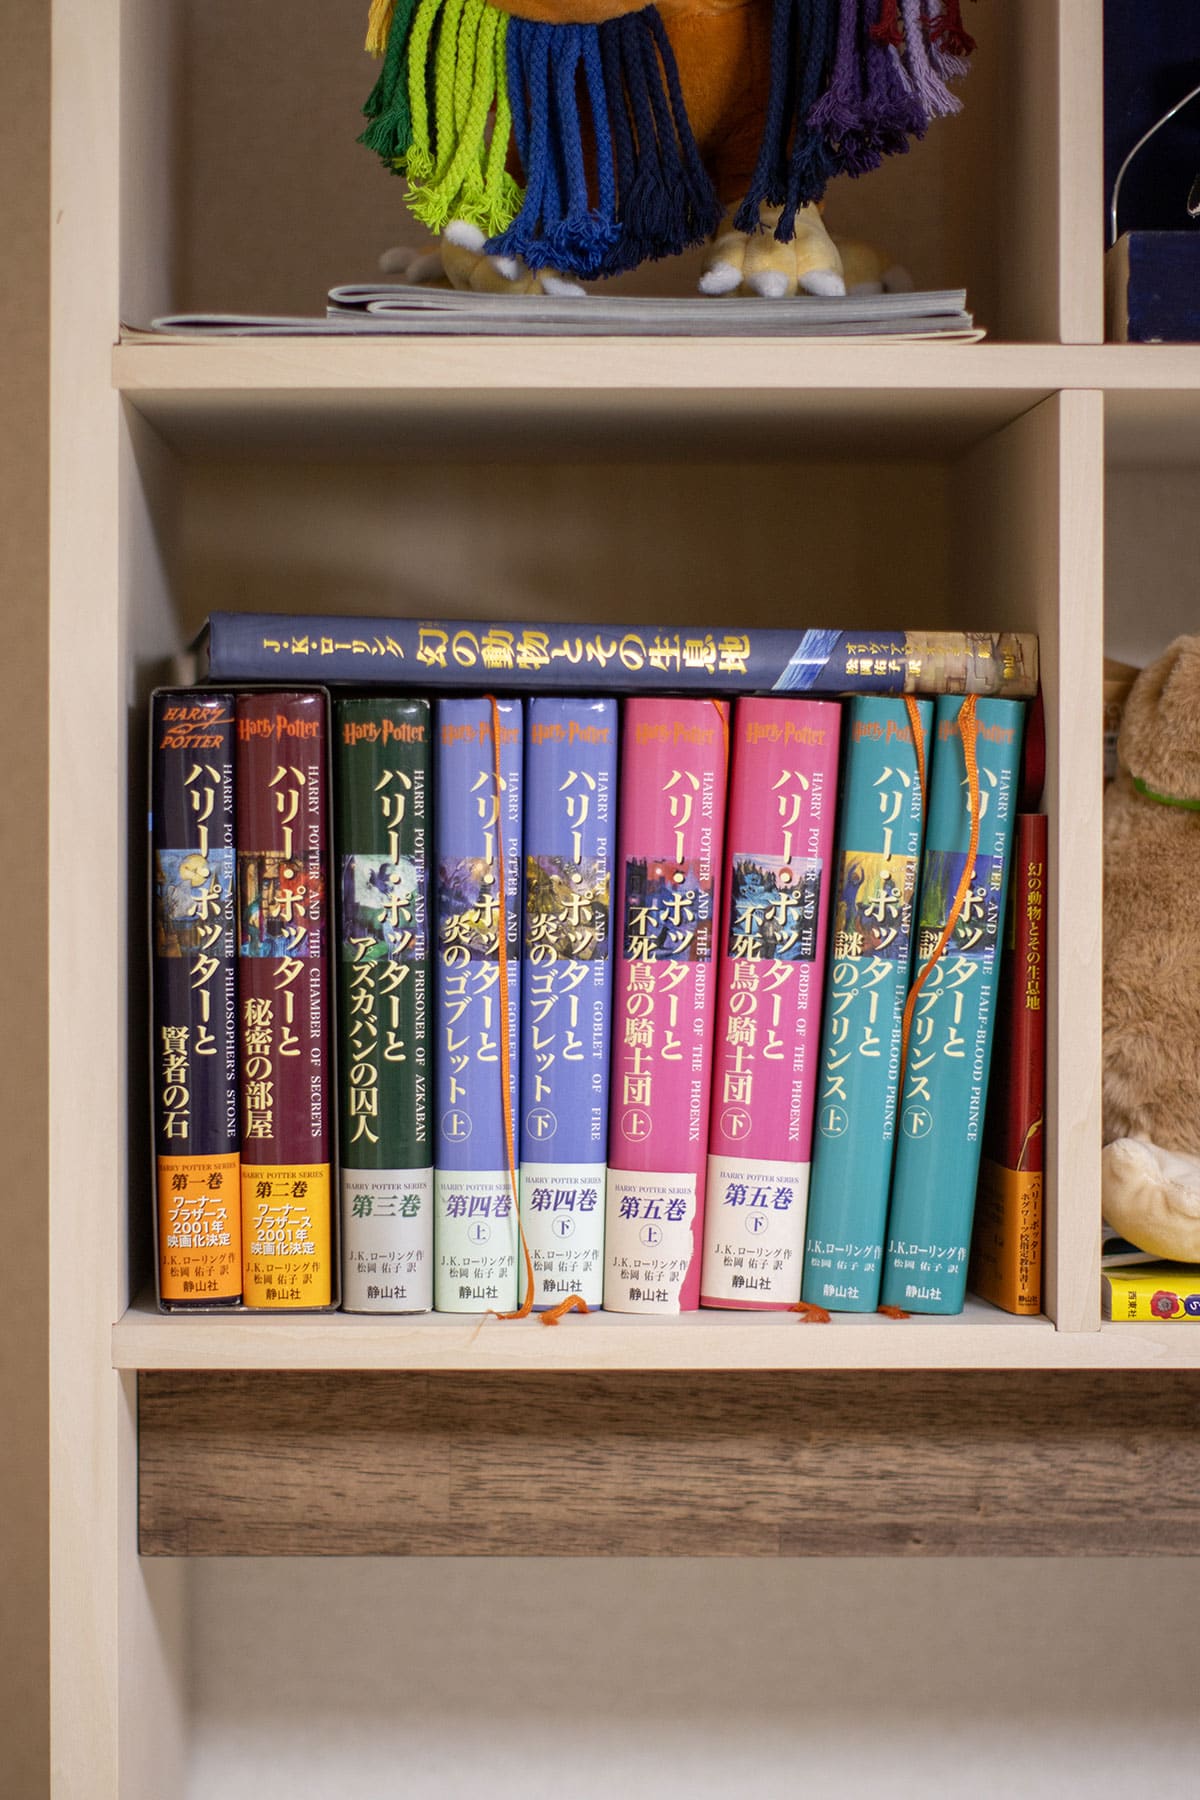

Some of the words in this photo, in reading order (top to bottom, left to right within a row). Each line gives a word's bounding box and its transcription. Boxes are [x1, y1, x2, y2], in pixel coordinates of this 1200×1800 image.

[416, 628, 751, 675] 幻の動物とその生息地
[162, 707, 227, 722] HARRY
[239, 719, 276, 742] Harry
[276, 714, 320, 742] Potter
[160, 735, 224, 749] POTTER
[343, 722, 381, 746] Harry
[382, 719, 425, 747] Potter
[531, 723, 567, 746] Harry
[568, 720, 610, 747] Potter
[636, 722, 672, 746] Harry
[673, 721, 715, 747] Potter
[746, 721, 783, 745] Harry
[784, 721, 826, 747] Potter
[852, 721, 885, 744] Harry
[223, 764, 233, 814] HARRY
[308, 765, 319, 815] HARRY
[414, 770, 425, 819] HARRY
[508, 772, 519, 823] HARRY
[597, 771, 608, 823] HARRY
[703, 772, 714, 819] HARRY
[810, 772, 824, 820] HARRY
[996, 769, 1011, 821] HARRY
[223, 823, 233, 880] POTTER
[308, 824, 320, 880] POTTER
[414, 828, 425, 884] POTTER
[596, 838, 607, 896] POTTER
[699, 828, 712, 881] POTTER
[806, 828, 820, 881] POTTER
[989, 832, 1006, 892] POTTER
[507, 838, 518, 897] POTTER
[184, 764, 223, 1057] ハリー・ポッターと
[223, 892, 234, 920] AND
[268, 765, 307, 1056] ハリー・ポッターと
[309, 895, 320, 920] AND
[374, 769, 412, 1062] ハリー・ポッターと
[414, 895, 425, 923] AND
[559, 770, 596, 1061] ハリー・ポッターと
[658, 770, 700, 1061] ハリー・ポッターと
[698, 889, 709, 920] AND
[762, 769, 809, 1060] ハリー・ポッターと
[803, 890, 815, 920] AND
[858, 766, 911, 1057] ハリー・ポッターと
[901, 902, 912, 934] AND
[987, 901, 999, 934] AND
[507, 911, 518, 942] AND
[594, 911, 606, 942] AND
[696, 927, 708, 957] THE
[801, 928, 813, 956] THE
[1025, 862, 1042, 1011] 幻の動物とその生息地
[225, 928, 235, 958] THE
[309, 929, 320, 959] THE
[415, 931, 425, 961] THE
[507, 956, 517, 987] THE
[593, 956, 604, 986] THE
[896, 944, 909, 975] THE
[982, 944, 995, 975] THE
[694, 963, 706, 1010] ORDER
[797, 963, 810, 1010] ORDER
[309, 967, 321, 1039] CHAMBER
[415, 969, 426, 1040] PRISONER
[443, 914, 472, 1104] 炎のゴブレット
[529, 912, 559, 1103] 炎のゴブレット
[623, 906, 658, 1106] 不死鳥の騎士団
[723, 905, 764, 1105] 不死鳥の騎士団
[822, 930, 865, 1101] 謎のプリンス
[225, 967, 236, 1081] PHILOSOPHER'S
[592, 1001, 604, 1059] GOBLET
[693, 1018, 704, 1037] OF
[796, 1018, 807, 1037] OF
[887, 984, 905, 1081] HALF-BLOOD
[972, 985, 991, 1081] HALF-BLOOD
[349, 936, 380, 1144] アズカバンの囚人
[244, 997, 275, 1139] 秘密の部屋
[310, 1047, 321, 1066] OF
[415, 1047, 426, 1067] OF
[691, 1043, 704, 1072] THE
[793, 1044, 805, 1072] THE
[161, 1025, 191, 1139] 賢者の石
[592, 1073, 602, 1094] OF
[226, 1090, 237, 1138] STONE
[311, 1075, 322, 1138] SECRETS
[415, 1073, 426, 1142] AZKABAN
[689, 1080, 702, 1141] PHOENIX
[788, 1080, 803, 1141] PHOENIX
[882, 1085, 896, 1141] PRINCE
[967, 1086, 981, 1141] PRINCE
[591, 1107, 601, 1141] FIRE
[171, 1172, 224, 1191] 第一巻
[256, 1180, 309, 1199] 第二巻
[723, 1183, 794, 1210] 第五巻
[168, 1208, 228, 1222] ブラザース
[173, 1196, 223, 1208] ワーナー
[257, 1204, 307, 1216] ワーナー
[351, 1194, 422, 1218] 第三巻
[446, 1194, 512, 1219] 第四巻
[530, 1188, 598, 1212] 第四巻
[618, 1196, 687, 1222] 第五巻
[173, 1221, 225, 1235] 2001年
[253, 1216, 313, 1229] ブラザース
[257, 1229, 309, 1242] 2001年
[167, 1233, 232, 1249] 映画化決定
[251, 1241, 316, 1256] 映画化決定
[183, 1280, 219, 1293] 静山社
[266, 1288, 302, 1300] 静山社
[367, 1285, 407, 1299] 静山社
[459, 1285, 499, 1299] 静山社
[543, 1279, 583, 1293] 静山社
[629, 1288, 669, 1302] 静山社
[732, 1275, 772, 1290] 静山社
[823, 1284, 860, 1299] 静山社
[905, 1285, 943, 1301] 静山社
